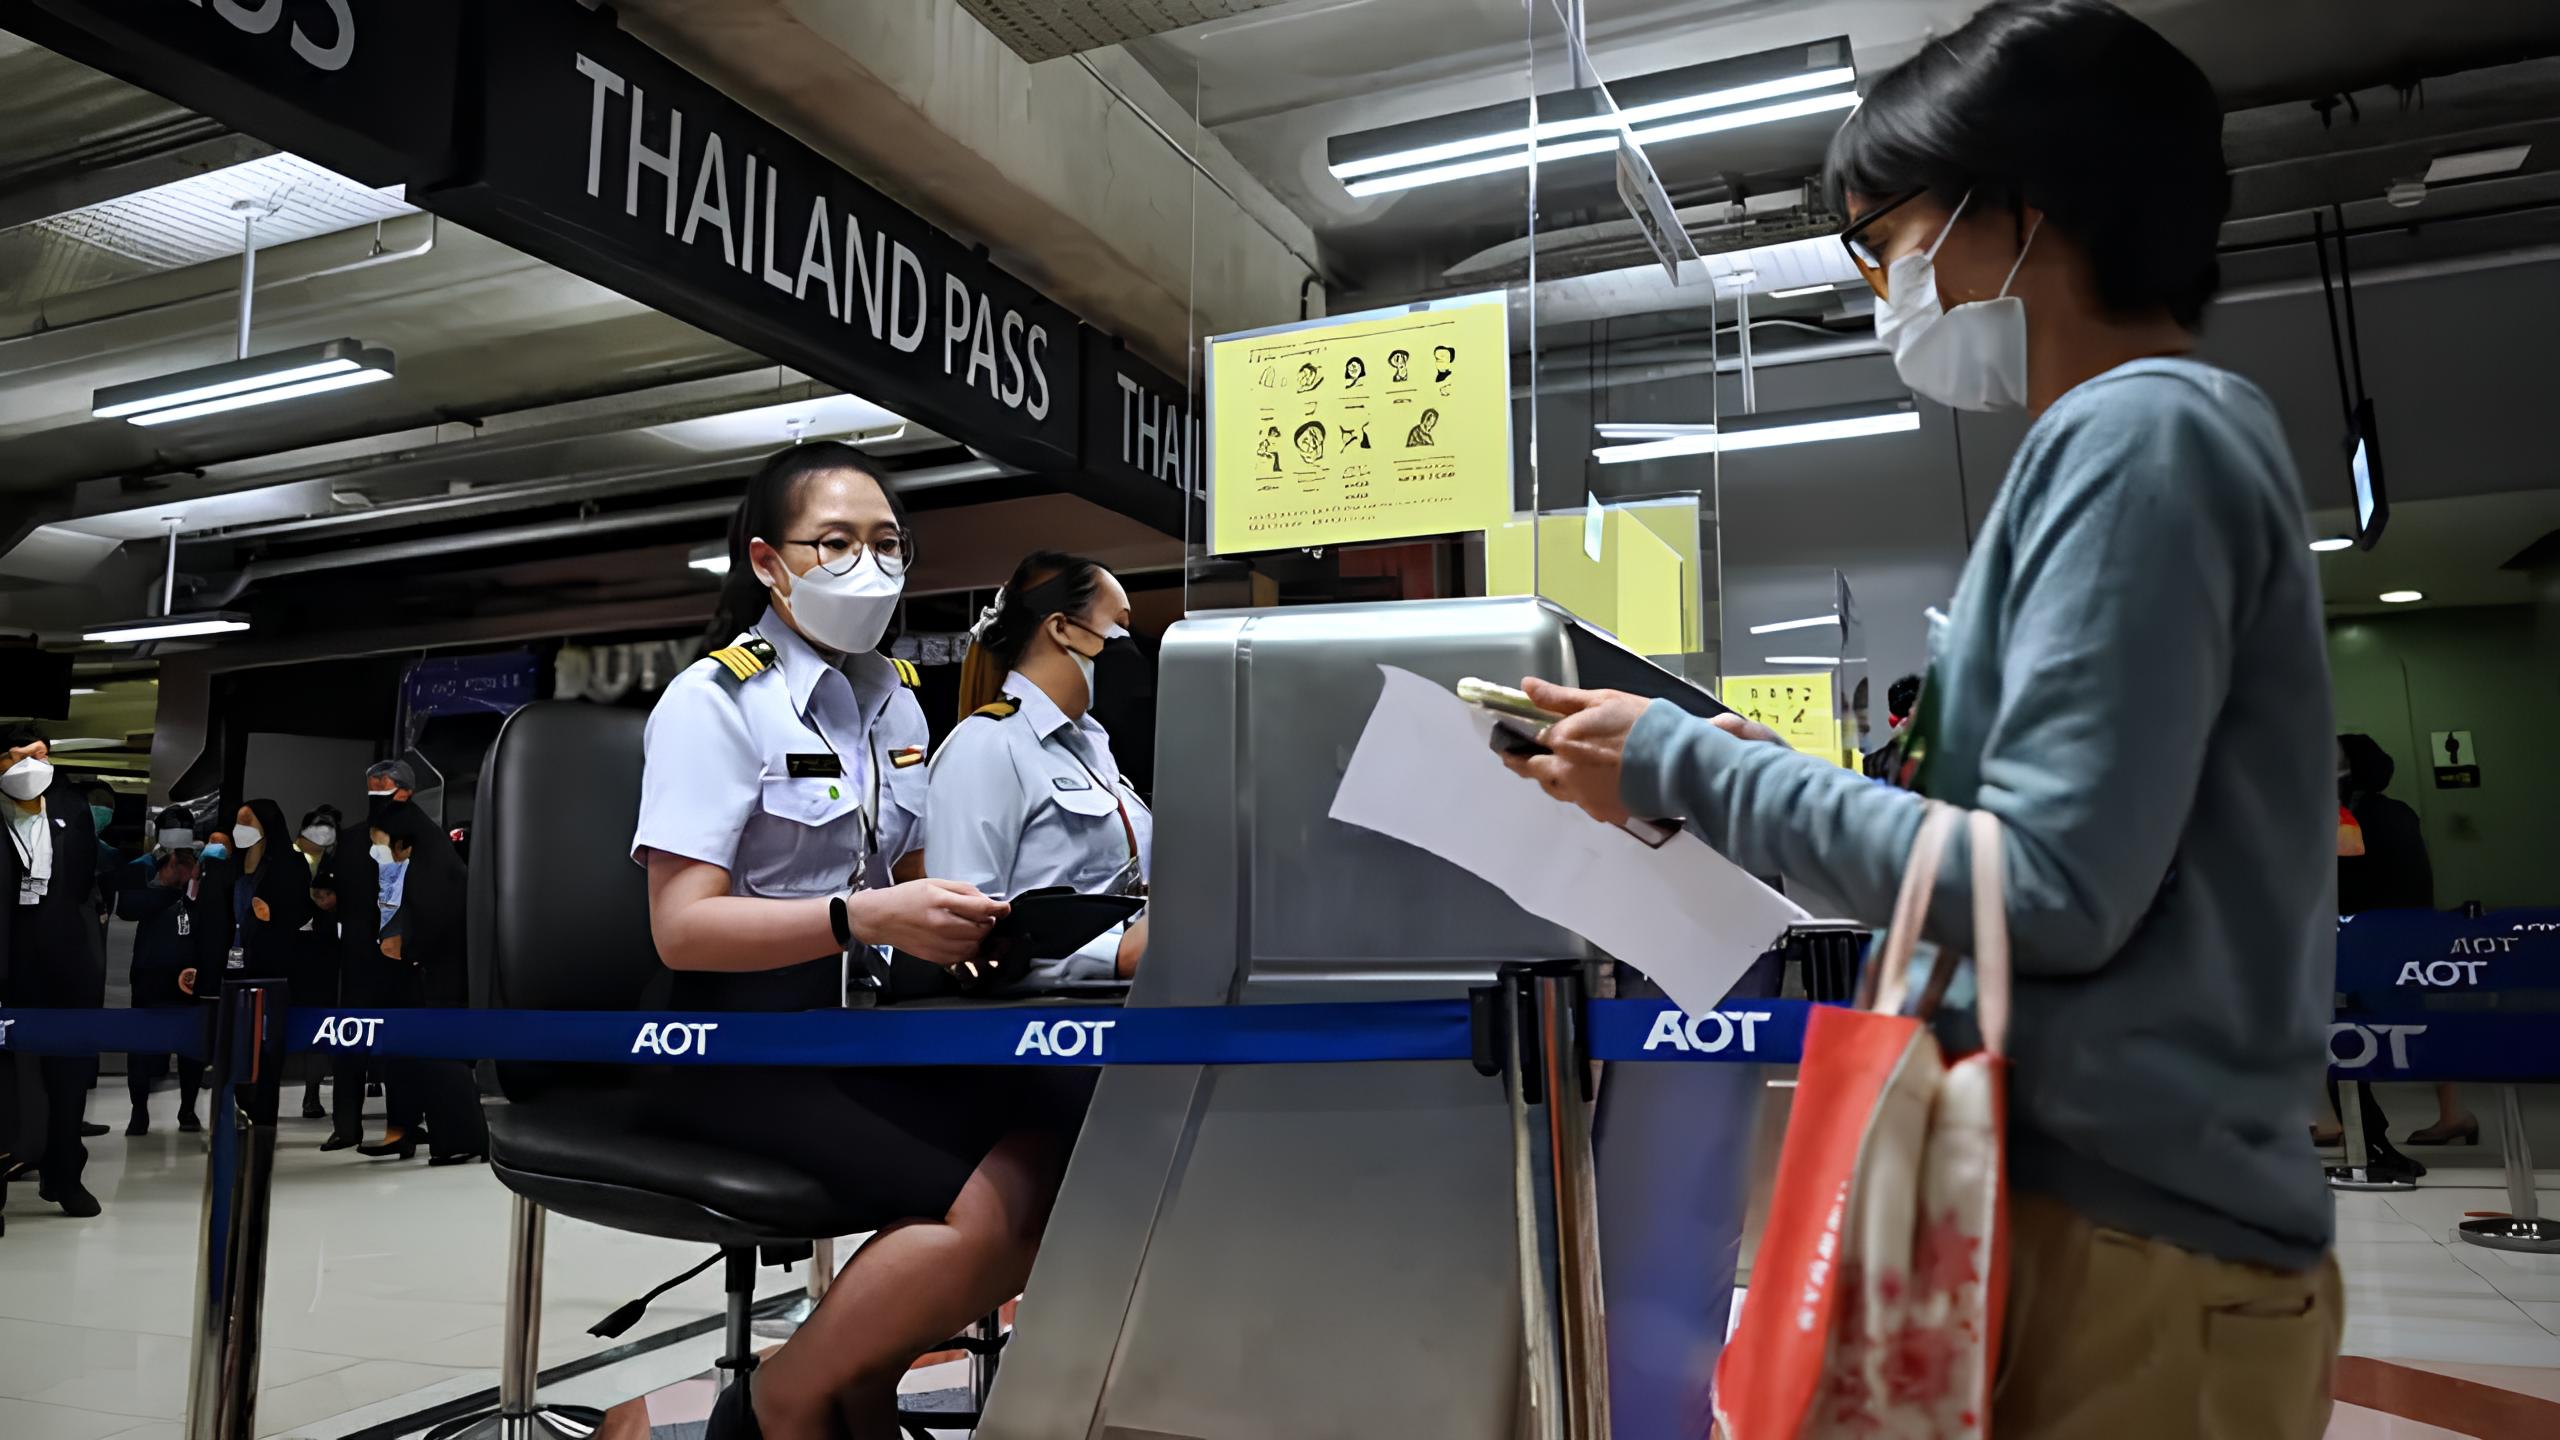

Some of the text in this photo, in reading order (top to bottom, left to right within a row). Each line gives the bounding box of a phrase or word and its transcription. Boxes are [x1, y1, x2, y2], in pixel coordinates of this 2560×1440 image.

[576, 52, 1049, 421] THAILAND PASS
[1117, 370, 1206, 501] THAIL
[2395, 960, 2489, 987] AOT
[312, 1016, 384, 1047] AOT
[631, 1021, 718, 1056] AOT
[1014, 1019, 1116, 1058] AOT
[1642, 1010, 1772, 1053] AOT
[2326, 1022, 2428, 1069] OT
